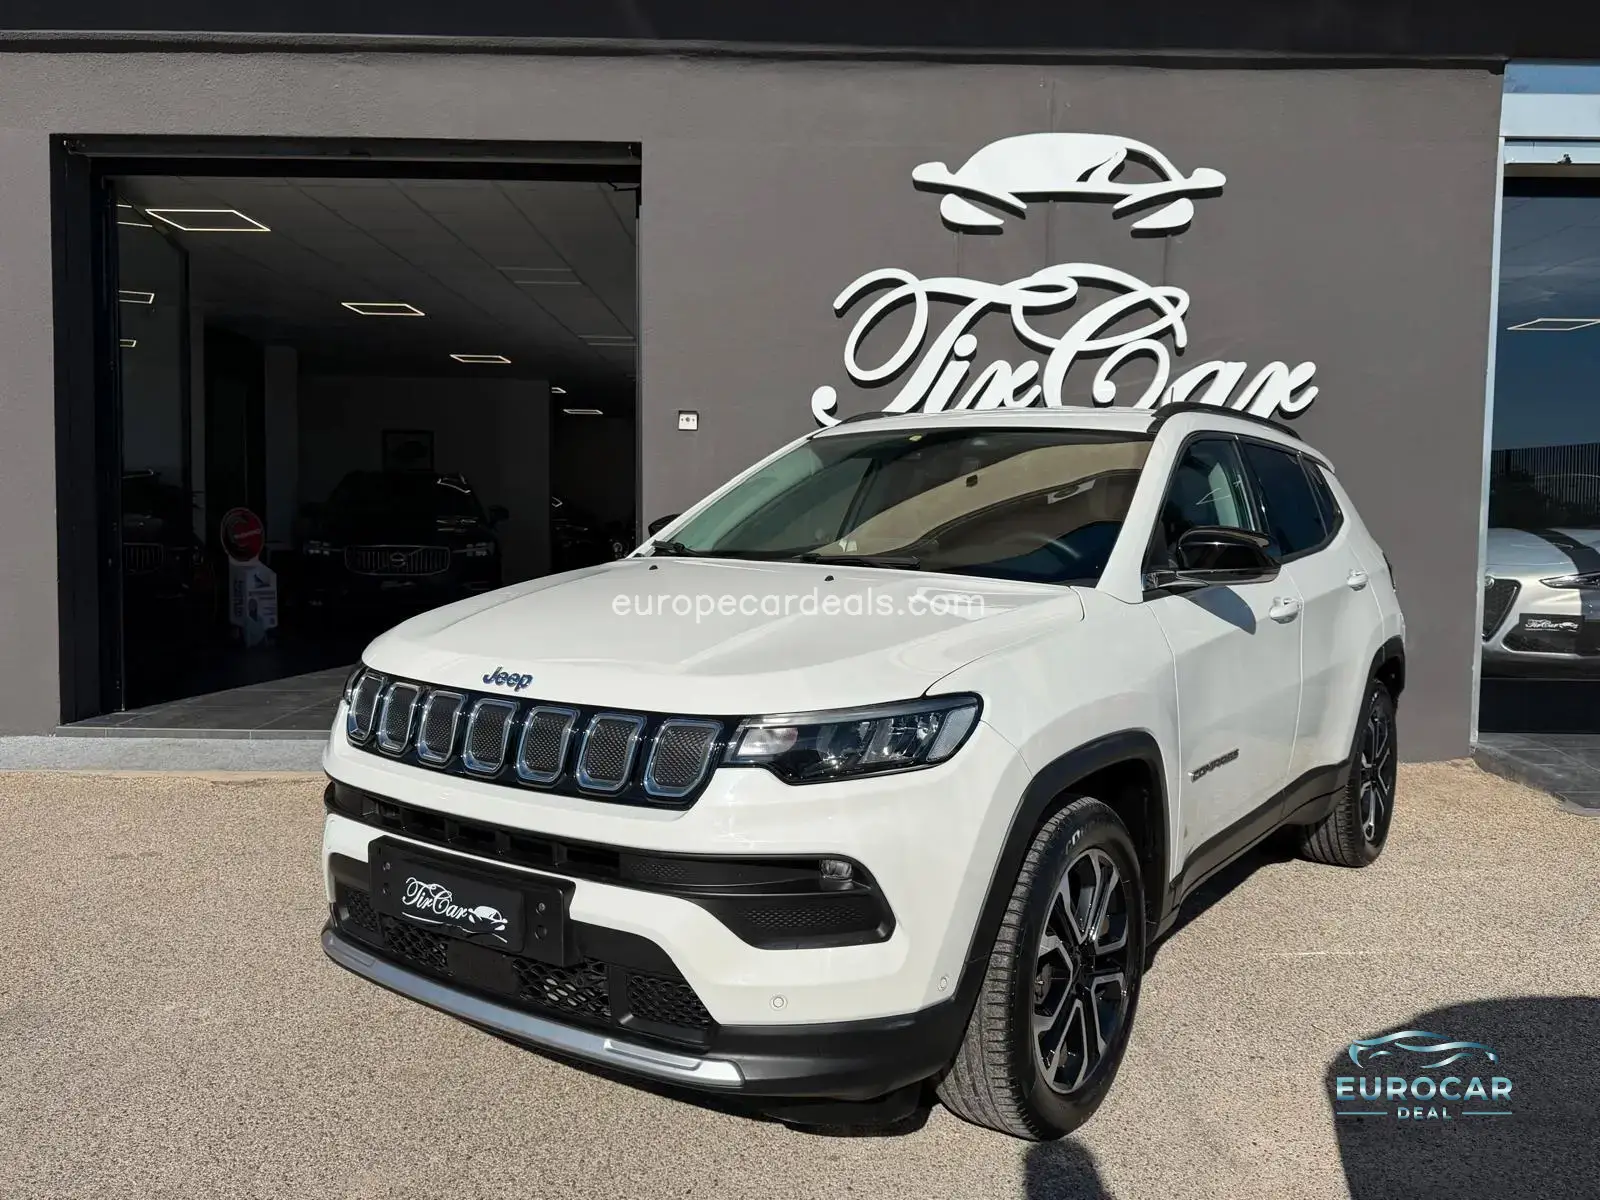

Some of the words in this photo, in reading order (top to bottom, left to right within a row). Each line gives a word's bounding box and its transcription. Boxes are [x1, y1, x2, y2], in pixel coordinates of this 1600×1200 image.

[811, 263, 1319, 427] TirCar
[482, 666, 533, 692] Jeep
[403, 877, 468, 919] TirCar
